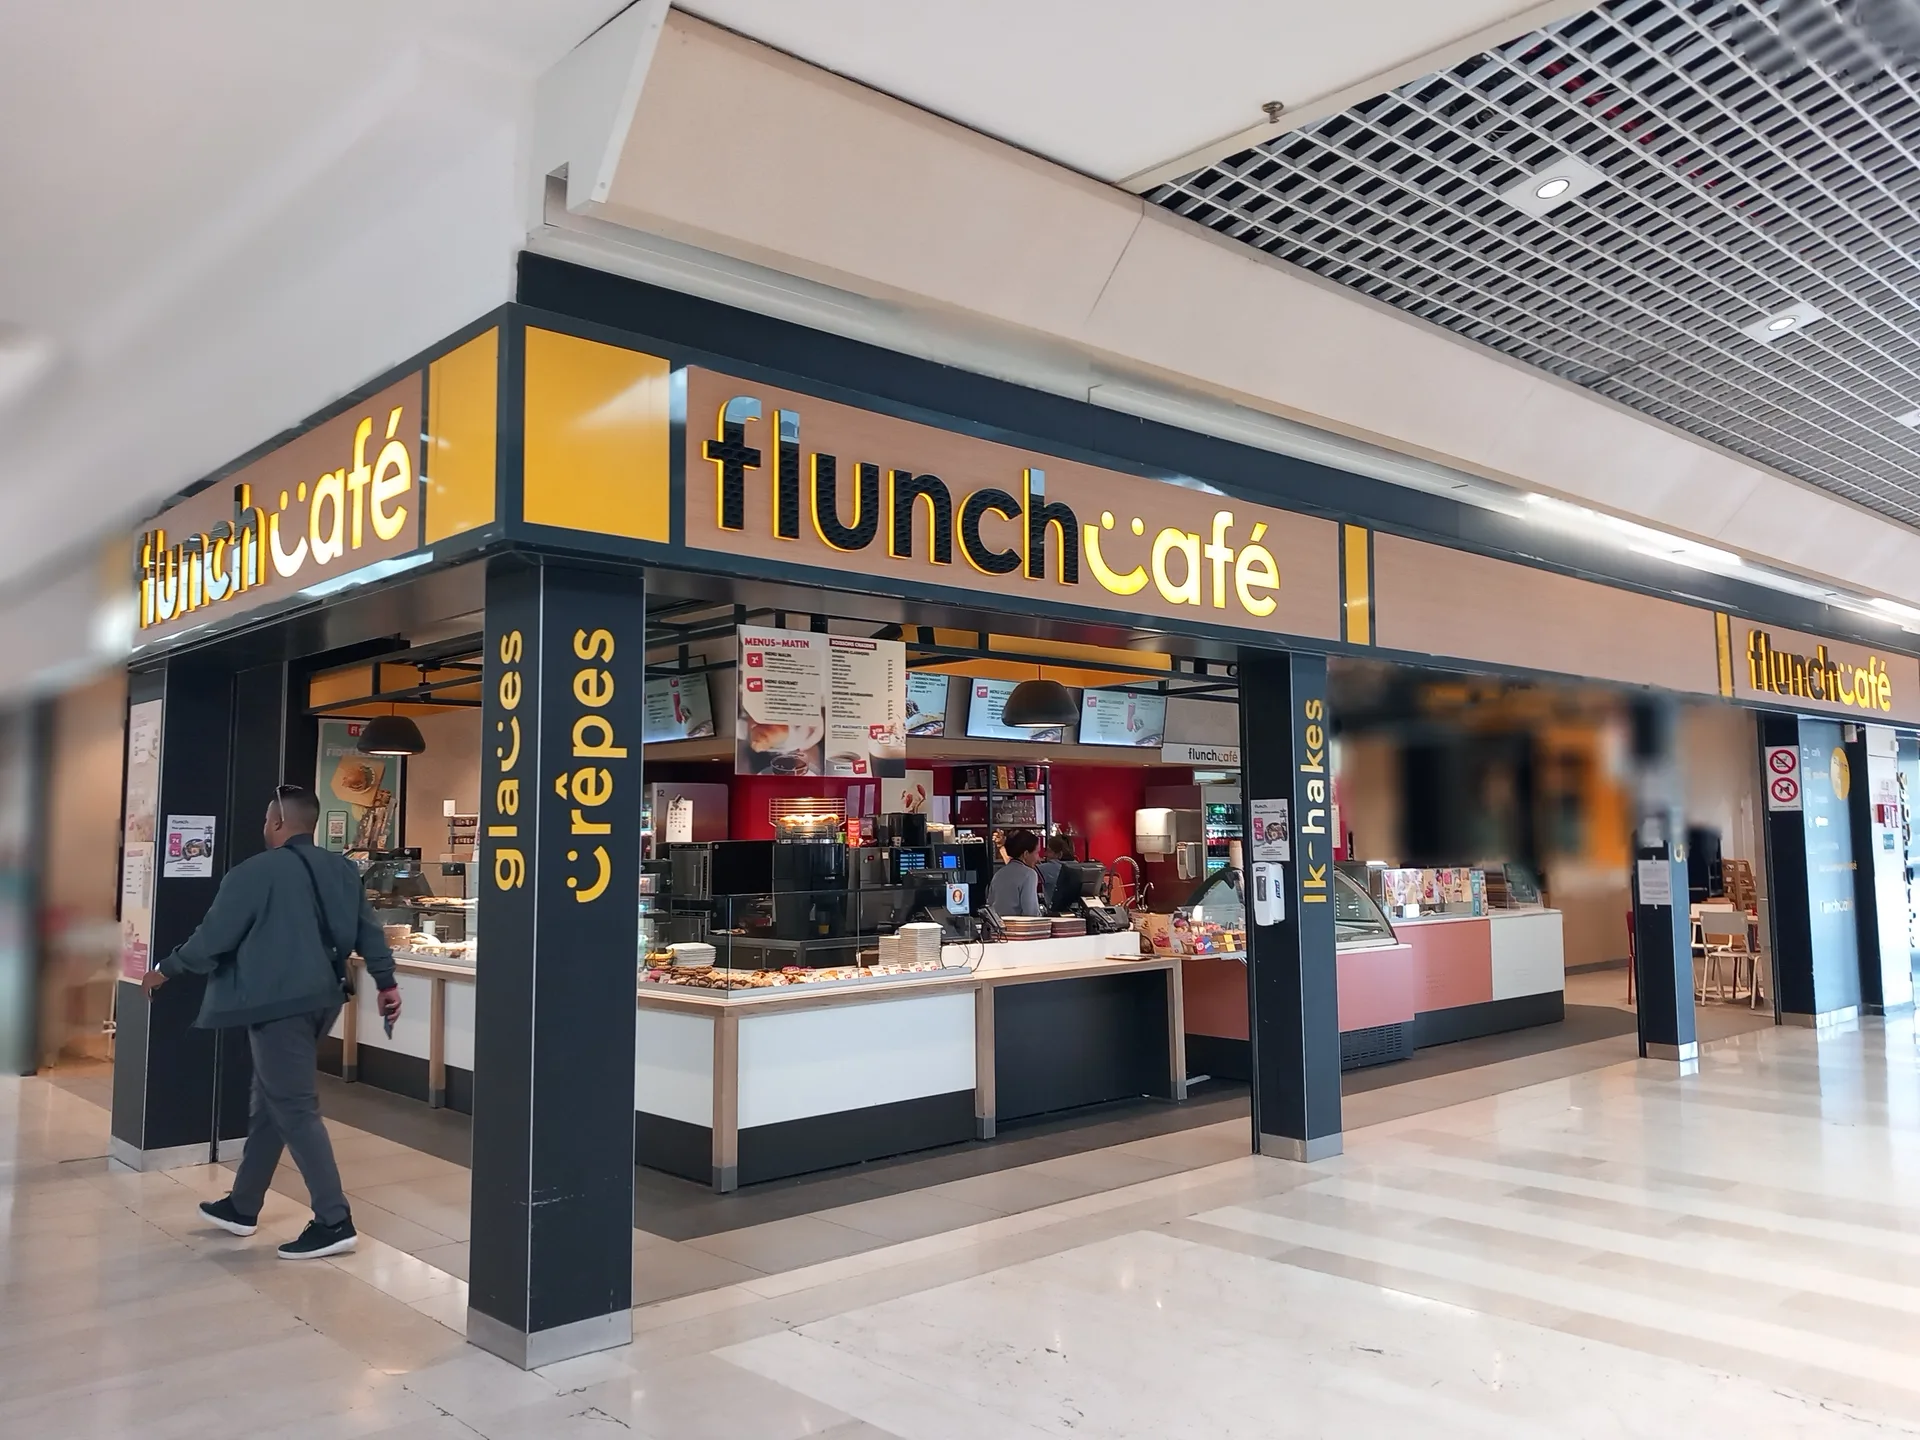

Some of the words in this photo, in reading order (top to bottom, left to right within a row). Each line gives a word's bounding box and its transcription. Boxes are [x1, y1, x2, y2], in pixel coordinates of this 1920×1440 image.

[744, 638, 775, 647] MENUS
[781, 640, 809, 648] MATIN
[657, 789, 665, 797] 12
